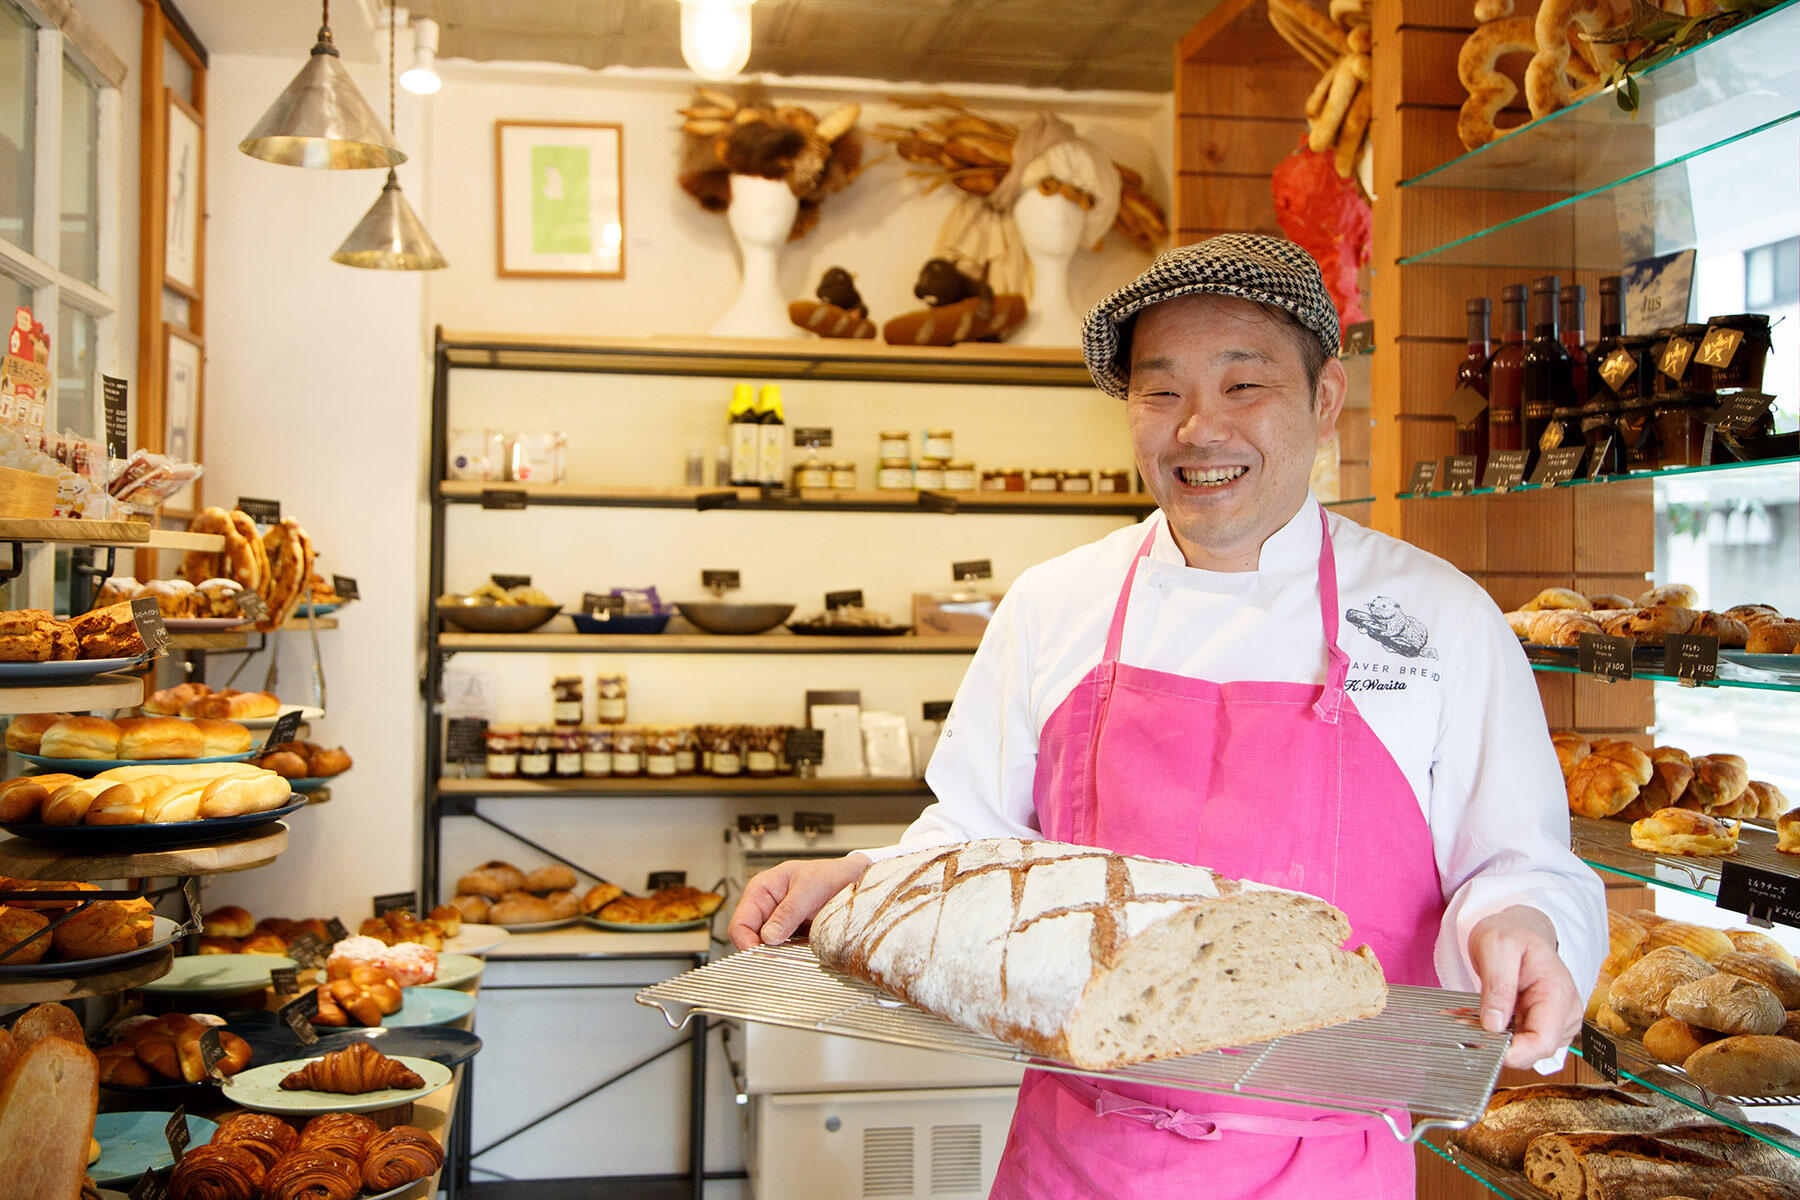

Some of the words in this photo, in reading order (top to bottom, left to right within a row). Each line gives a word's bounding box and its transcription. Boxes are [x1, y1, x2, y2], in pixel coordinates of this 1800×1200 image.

[1352, 662, 1390, 673] AVER
[1399, 666, 1440, 682] BRED
[1344, 679, 1407, 692] K.Warita
